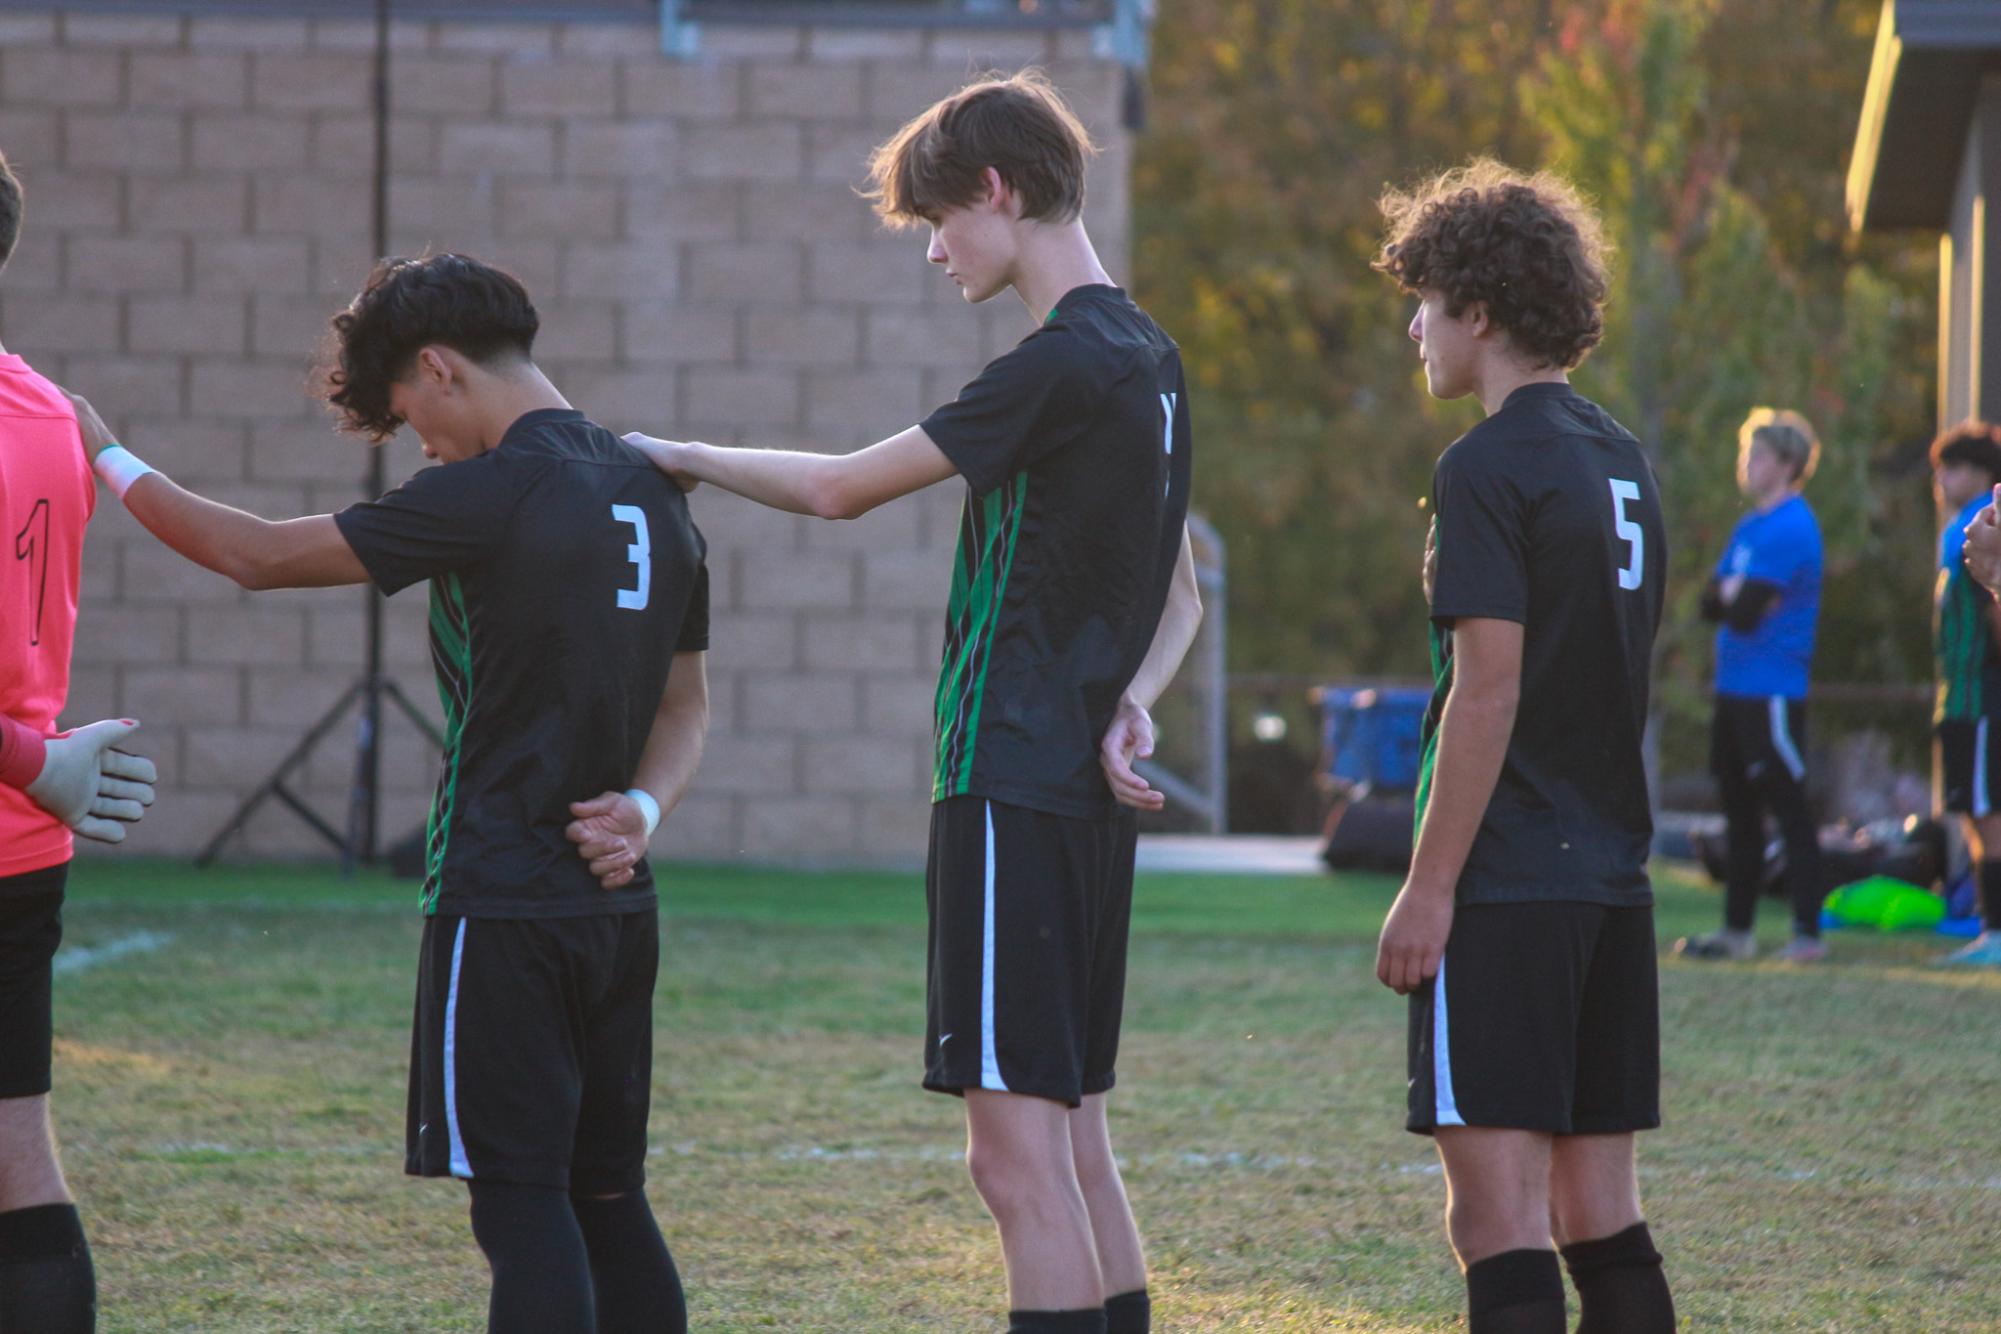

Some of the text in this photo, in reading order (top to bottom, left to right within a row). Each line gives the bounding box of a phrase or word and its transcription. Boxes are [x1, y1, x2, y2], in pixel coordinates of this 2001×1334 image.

[16, 498, 49, 646] 1
[611, 503, 651, 611] 3
[1608, 477, 1645, 591] 5
